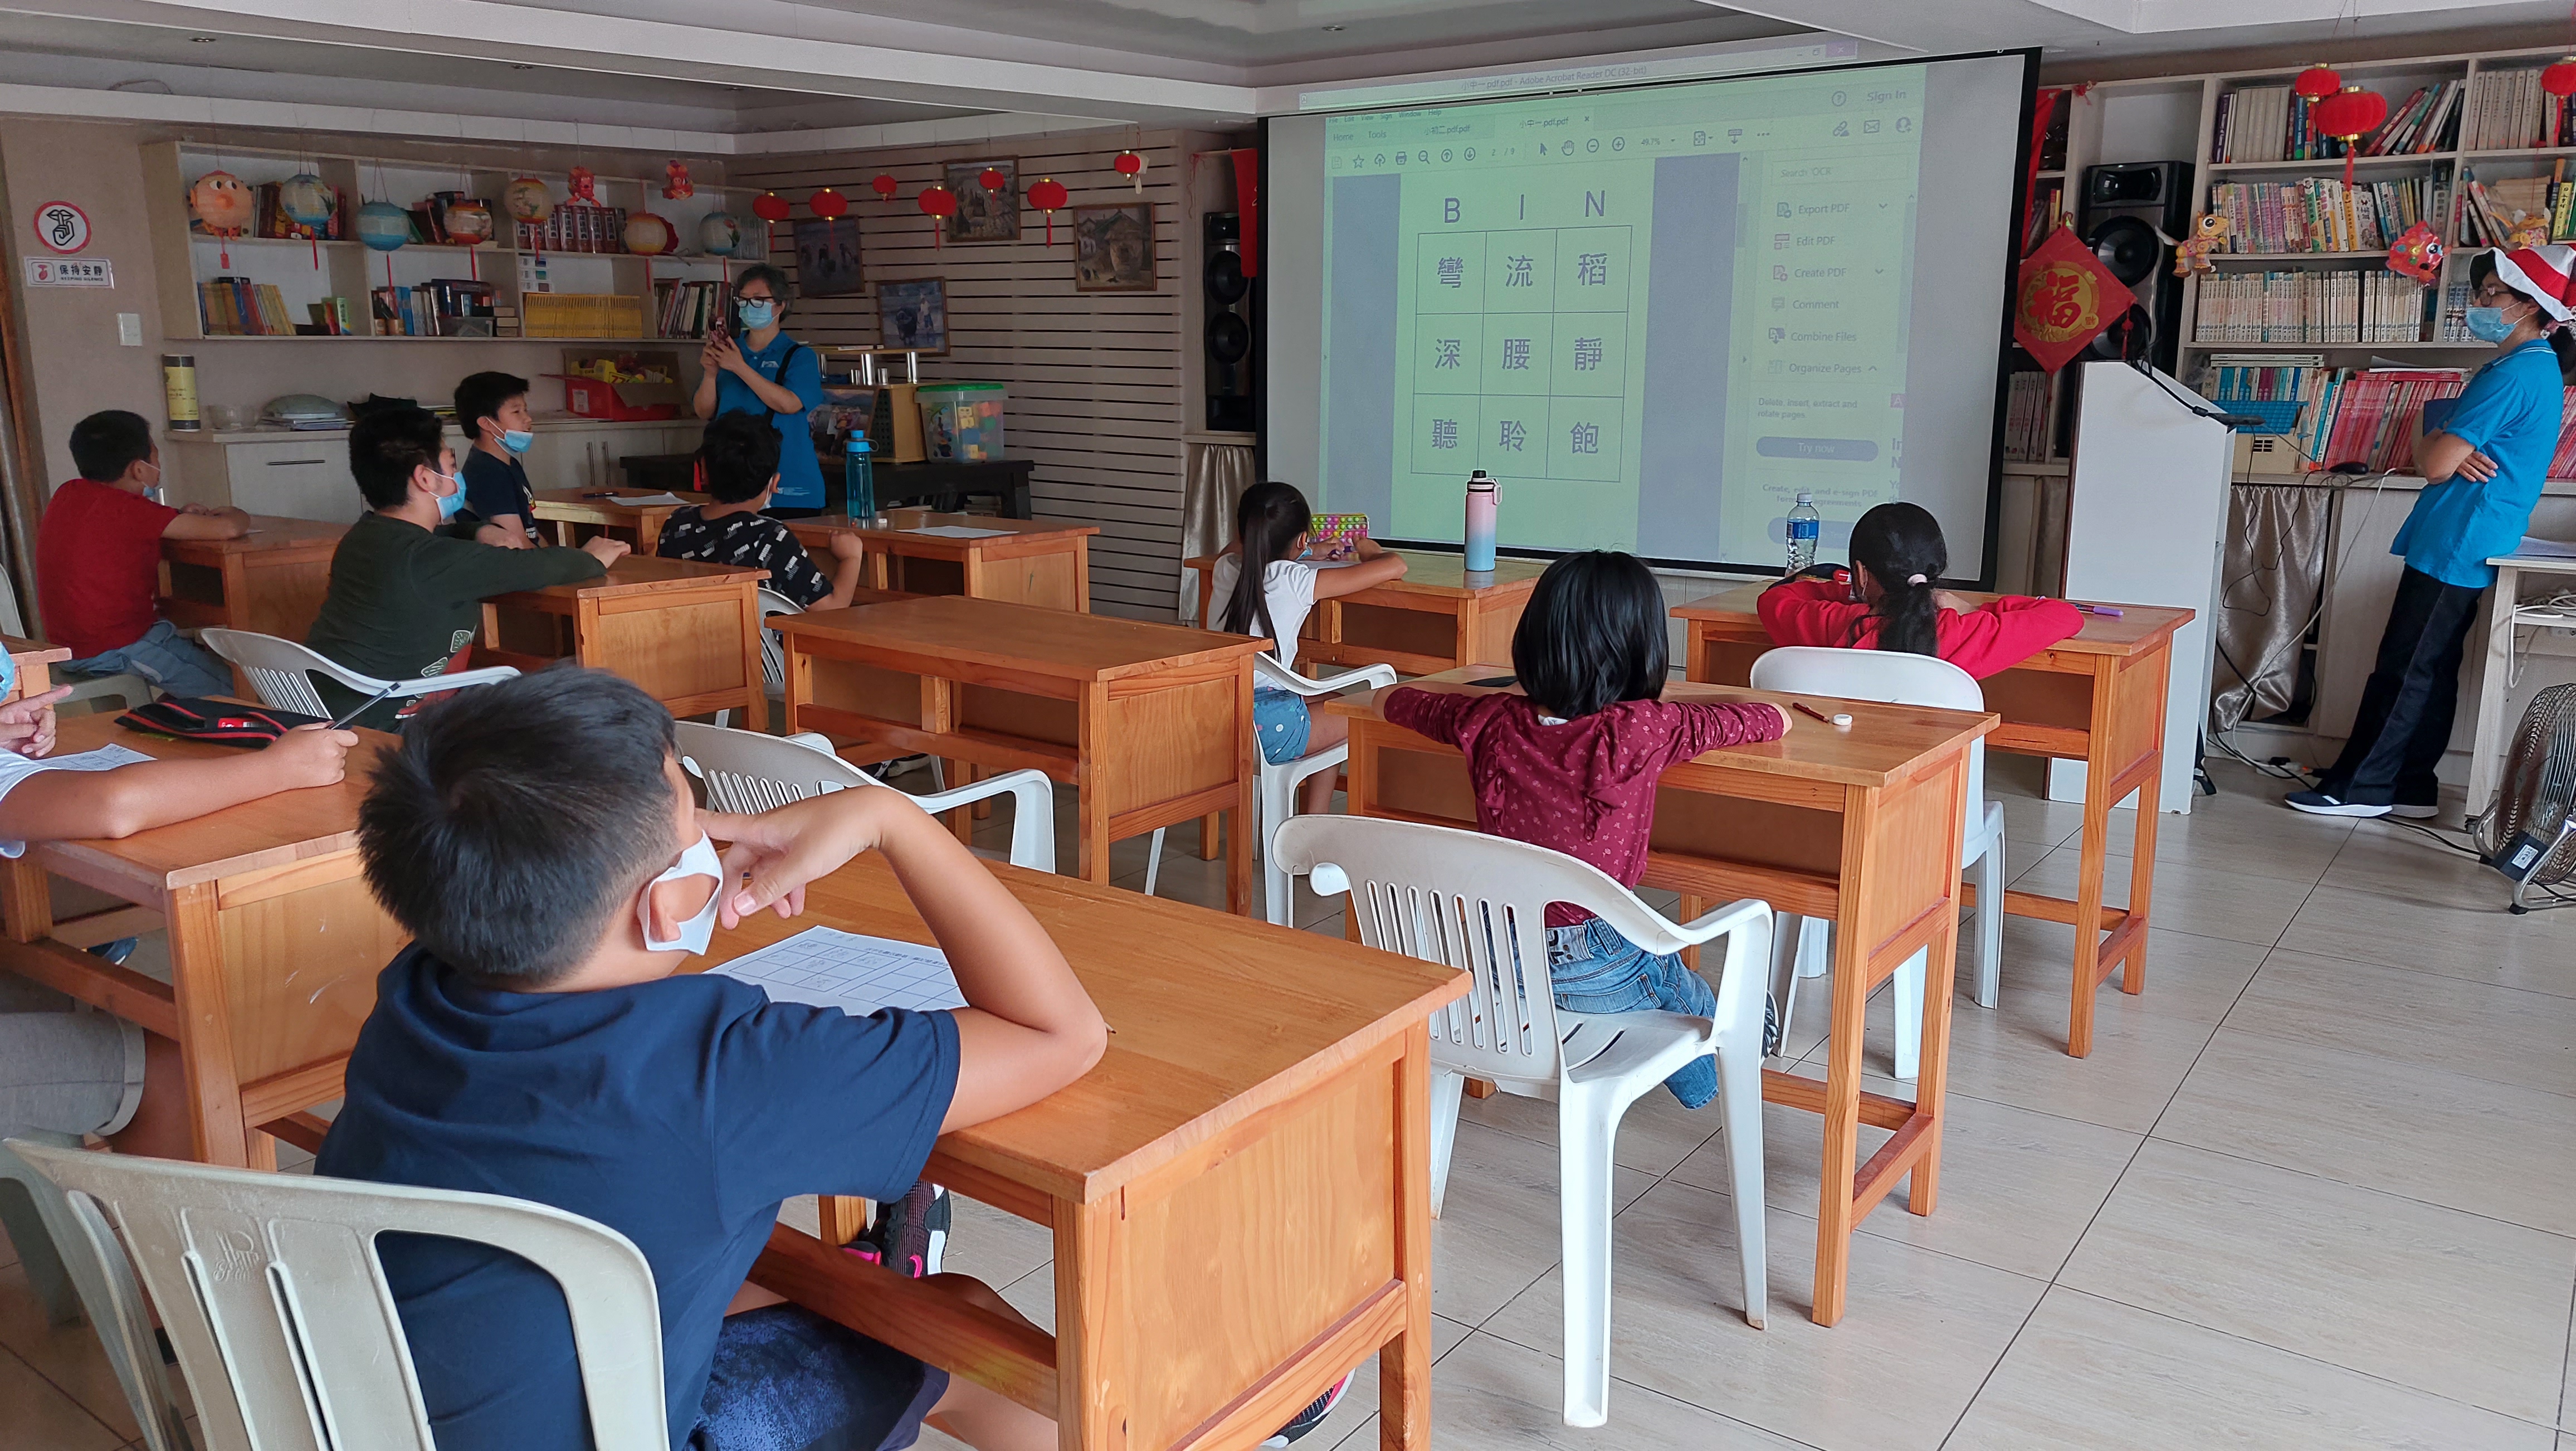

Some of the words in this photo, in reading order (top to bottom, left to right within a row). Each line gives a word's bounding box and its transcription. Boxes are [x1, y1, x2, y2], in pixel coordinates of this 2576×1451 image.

[1520, 76, 1544, 85] Adobe
[1546, 74, 1575, 82] Acrobat
[1577, 72, 1603, 80] Reader
[1605, 69, 1615, 77] DC
[1618, 66, 1647, 77] (32-bit)
[1867, 91, 1891, 104] Sign
[1444, 197, 1461, 223] B
[1519, 194, 1525, 220] I
[1584, 190, 1606, 217] N
[1798, 204, 1828, 216] Export
[1830, 203, 1850, 213] PDF
[1796, 237, 1814, 246] Edit
[1816, 236, 1836, 245] PDF
[1437, 256, 1464, 288] 彎
[1505, 255, 1534, 288] 流
[1577, 252, 1607, 286] 稻
[1794, 269, 1825, 278] Create
[1827, 267, 1847, 277] PDF
[1793, 300, 1840, 310] Comment
[2028, 271, 2082, 329] 福
[1790, 332, 1833, 342] Combine
[1835, 332, 1857, 342] Files
[1435, 338, 1461, 370] 深
[1501, 339, 1531, 371] 腰
[1574, 337, 1603, 371] 靜
[1789, 363, 1832, 375] Organize
[1834, 364, 1862, 376] Pages
[1813, 400, 1840, 408] extract
[1842, 400, 1858, 408] and
[1432, 419, 1457, 450] 聽
[1499, 421, 1527, 452] 聆
[1570, 422, 1599, 454] 飽
[1798, 442, 1812, 454] Try
[1833, 489, 1860, 498] e-sign
